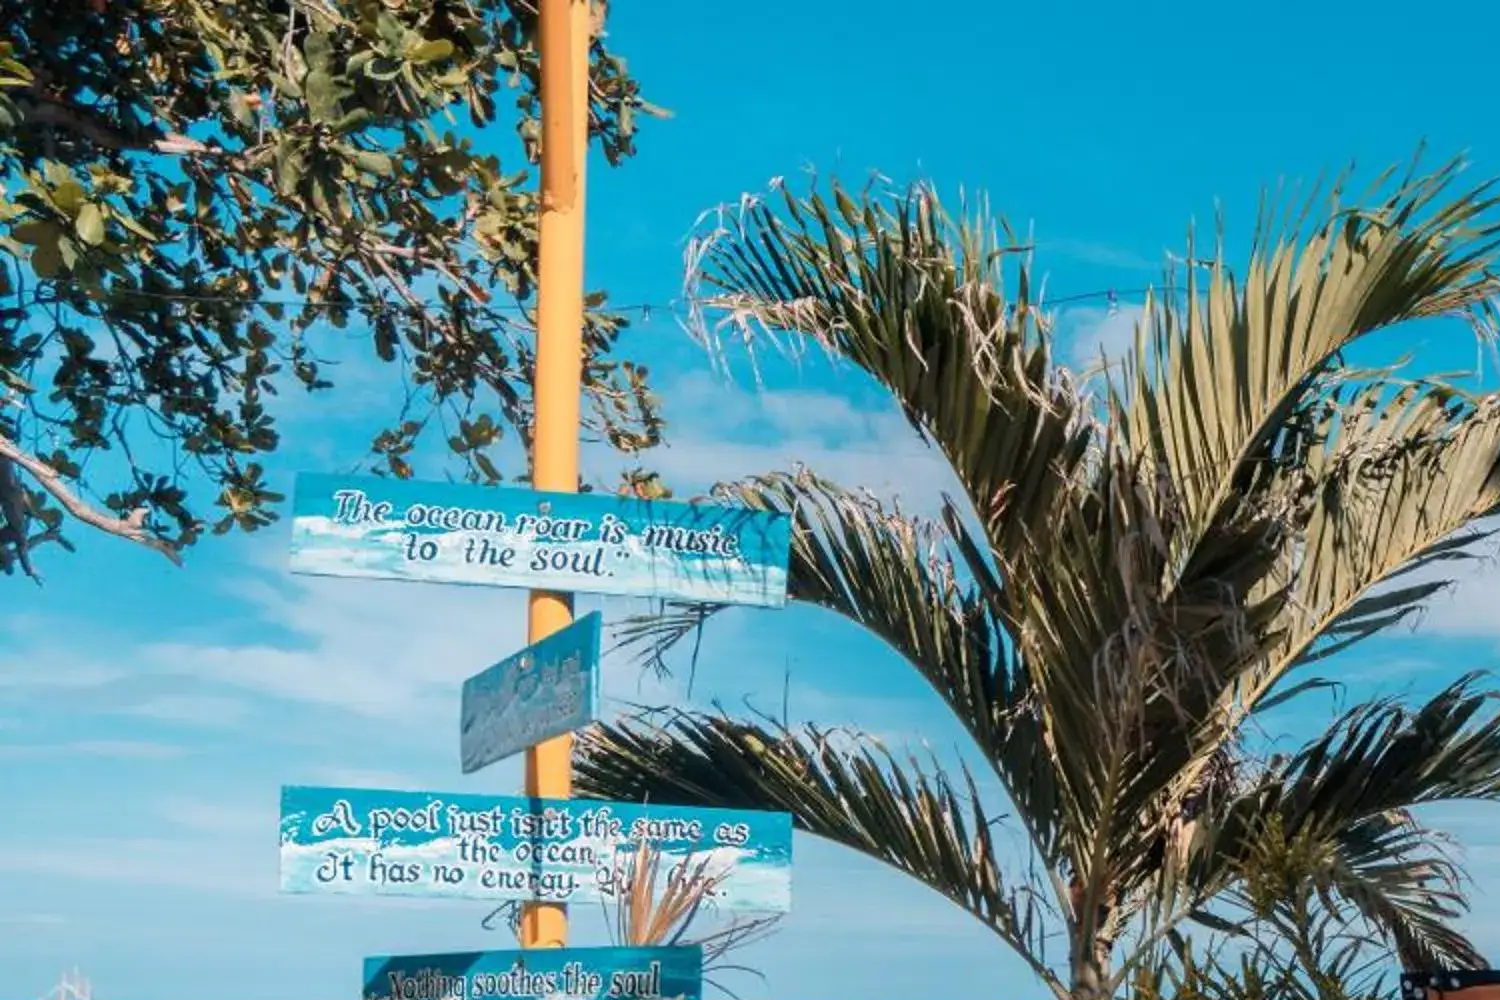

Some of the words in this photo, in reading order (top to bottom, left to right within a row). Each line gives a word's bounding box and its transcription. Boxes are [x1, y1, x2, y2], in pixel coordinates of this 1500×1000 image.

[334, 491, 391, 524] The
[407, 505, 503, 533] ocean
[516, 514, 590, 539] roar
[600, 514, 626, 545] is
[644, 522, 737, 556] music
[405, 533, 438, 561] to
[464, 538, 516, 567] the
[315, 800, 360, 834] A
[370, 801, 441, 838] pool
[449, 804, 502, 836] just
[579, 807, 621, 838] the
[632, 817, 701, 841] same
[714, 823, 748, 842] as
[456, 836, 499, 864] the
[315, 852, 354, 881] It
[367, 852, 420, 885] has
[433, 863, 464, 883] no
[481, 869, 580, 898] energy.
[472, 962, 557, 997] soothes
[561, 962, 601, 996] the
[609, 961, 661, 996] soul
